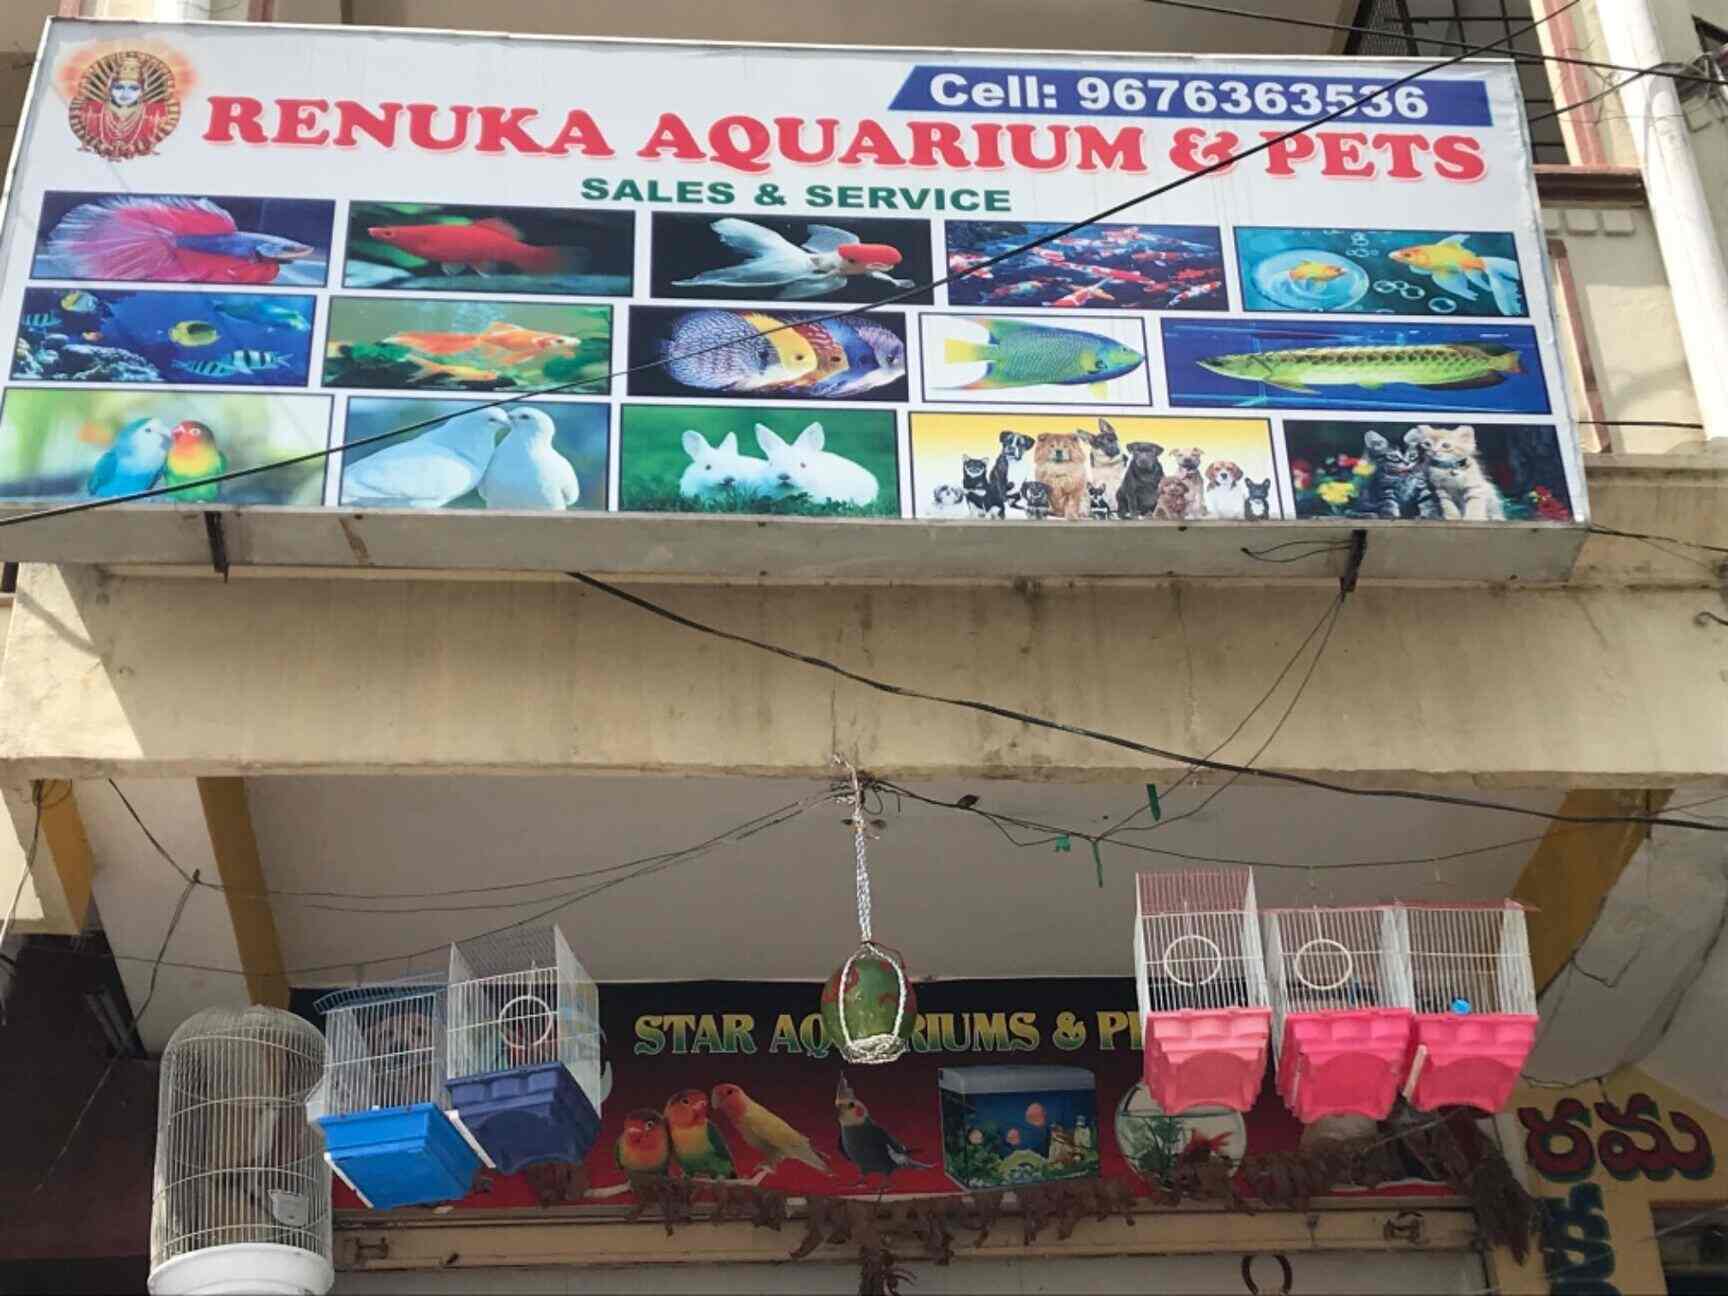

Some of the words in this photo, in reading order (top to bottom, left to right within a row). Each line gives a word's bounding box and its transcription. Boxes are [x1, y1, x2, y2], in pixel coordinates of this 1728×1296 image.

[930, 73, 1057, 110] Cell:
[1076, 76, 1429, 120] 9676363536
[204, 95, 614, 158] RENUKA
[637, 112, 1146, 175] AQUARIUM
[1168, 127, 1240, 174] &
[1263, 130, 1486, 183] PETS
[582, 177, 735, 205] SALES
[753, 184, 786, 207] &
[806, 184, 1011, 212] SERVICE
[633, 1013, 757, 1055] STAR
[769, 1012, 1040, 1059] AQRIUMS
[1052, 1011, 1087, 1051] &
